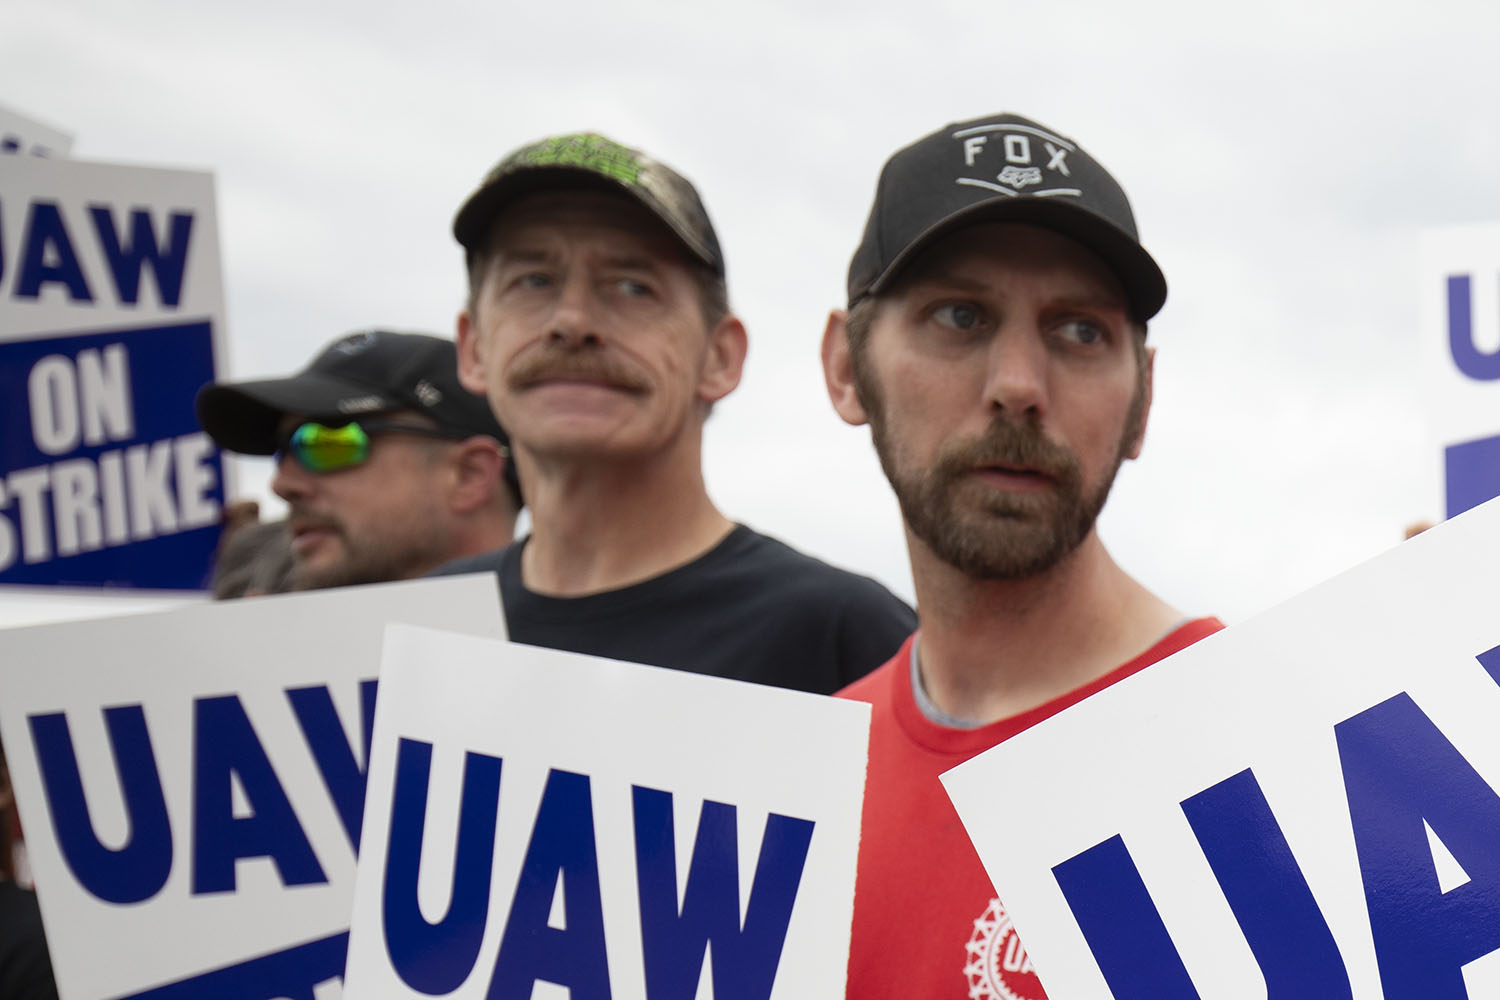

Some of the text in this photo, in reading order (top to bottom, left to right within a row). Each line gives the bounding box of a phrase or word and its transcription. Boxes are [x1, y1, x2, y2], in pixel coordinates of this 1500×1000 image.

[964, 134, 1071, 177] FOX
[0, 198, 196, 307] AW
[28, 343, 134, 455] ON
